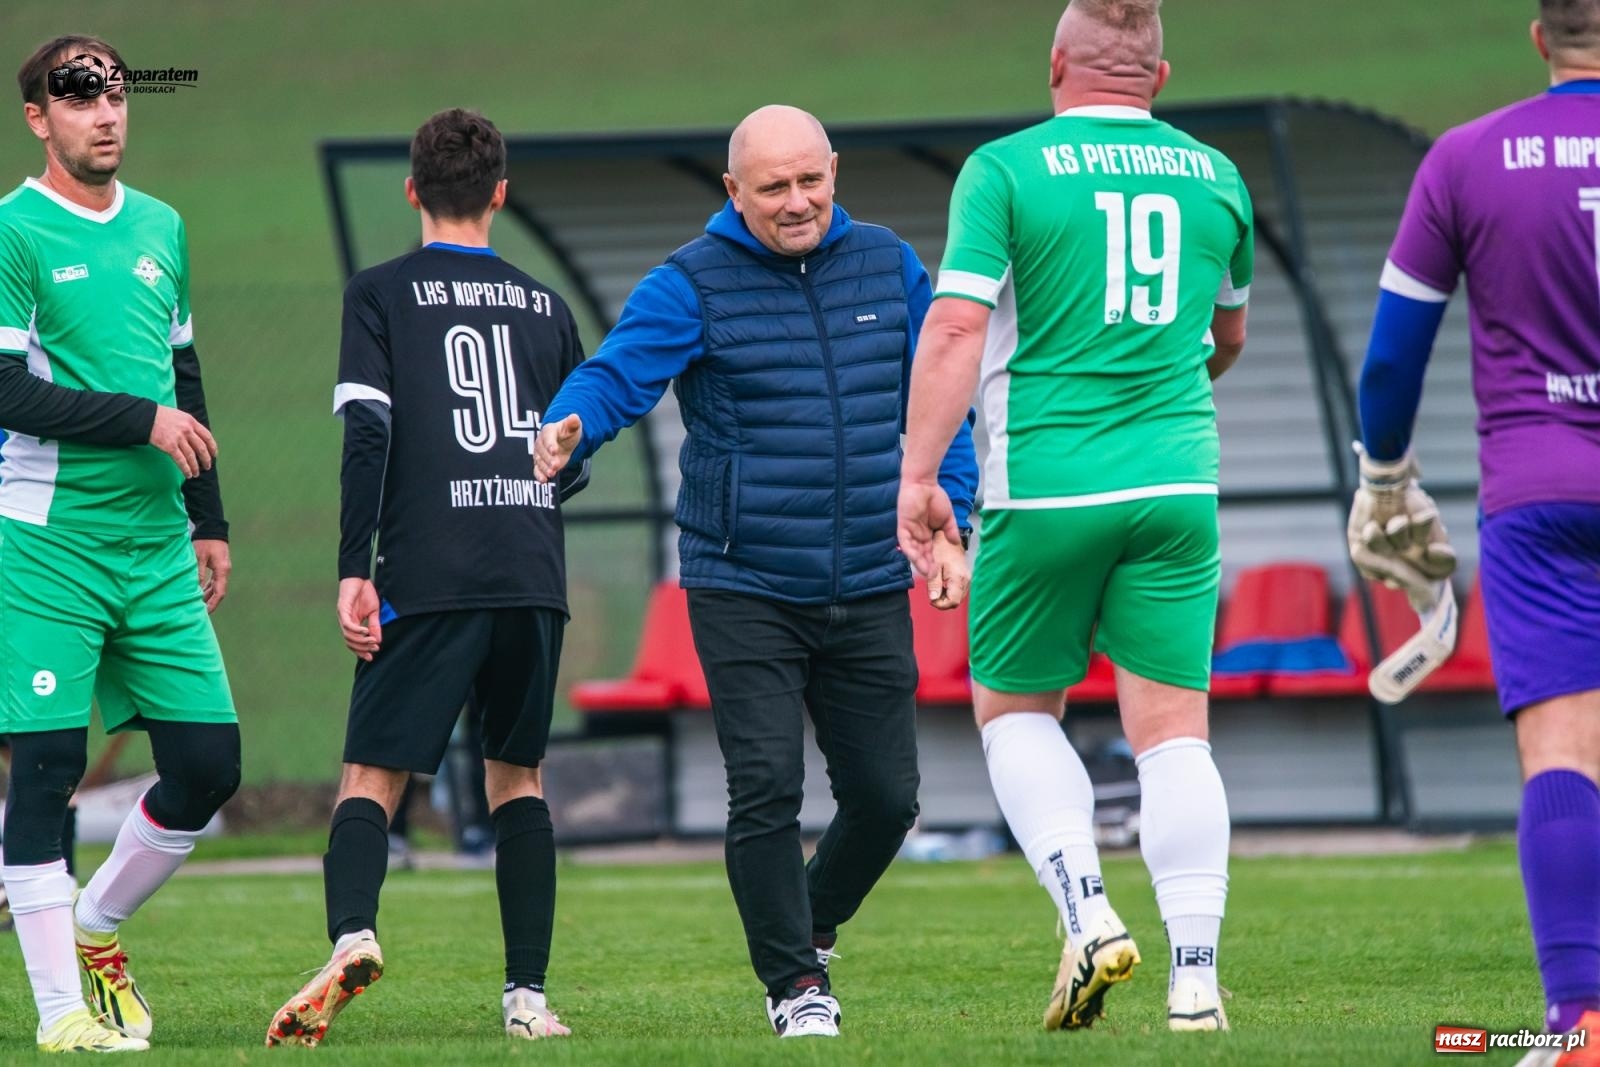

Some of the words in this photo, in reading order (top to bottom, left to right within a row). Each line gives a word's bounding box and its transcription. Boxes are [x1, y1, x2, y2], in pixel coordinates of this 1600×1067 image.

[1042, 144, 1080, 176] KS
[1080, 143, 1216, 182] PIETRASZYN
[1094, 191, 1181, 325] 19
[452, 281, 527, 309] NAPRZÓD
[531, 290, 552, 316] 37
[444, 324, 541, 455] 94
[1179, 949, 1213, 966] FS
